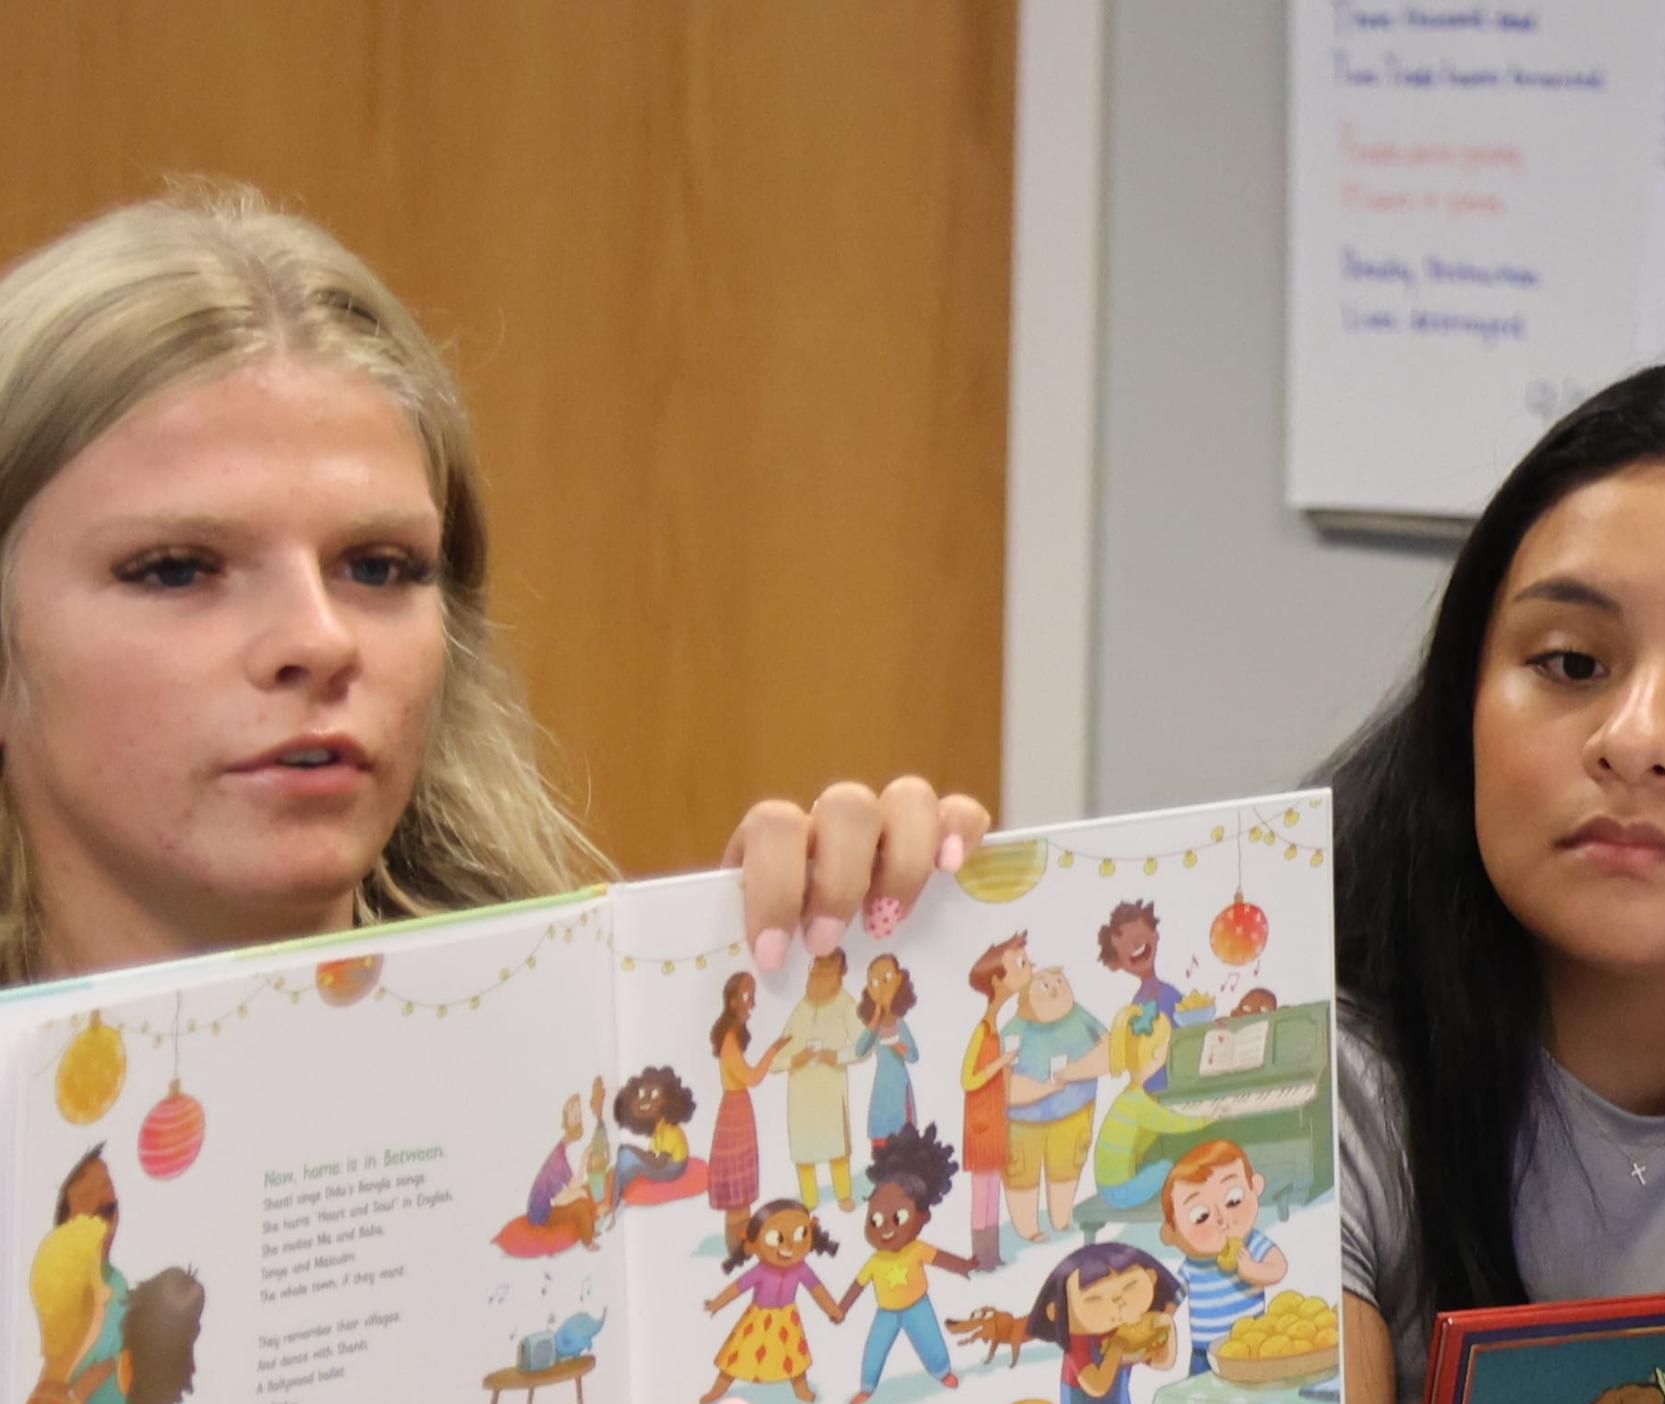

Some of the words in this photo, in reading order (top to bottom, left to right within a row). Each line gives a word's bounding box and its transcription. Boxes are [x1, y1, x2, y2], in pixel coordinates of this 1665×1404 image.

[303, 1163, 340, 1181] home
[346, 1156, 357, 1173] is
[364, 1154, 376, 1170] in
[349, 1203, 369, 1217] and
[336, 1229, 355, 1241] and
[291, 1261, 310, 1274] and
[313, 1346, 333, 1359] with
